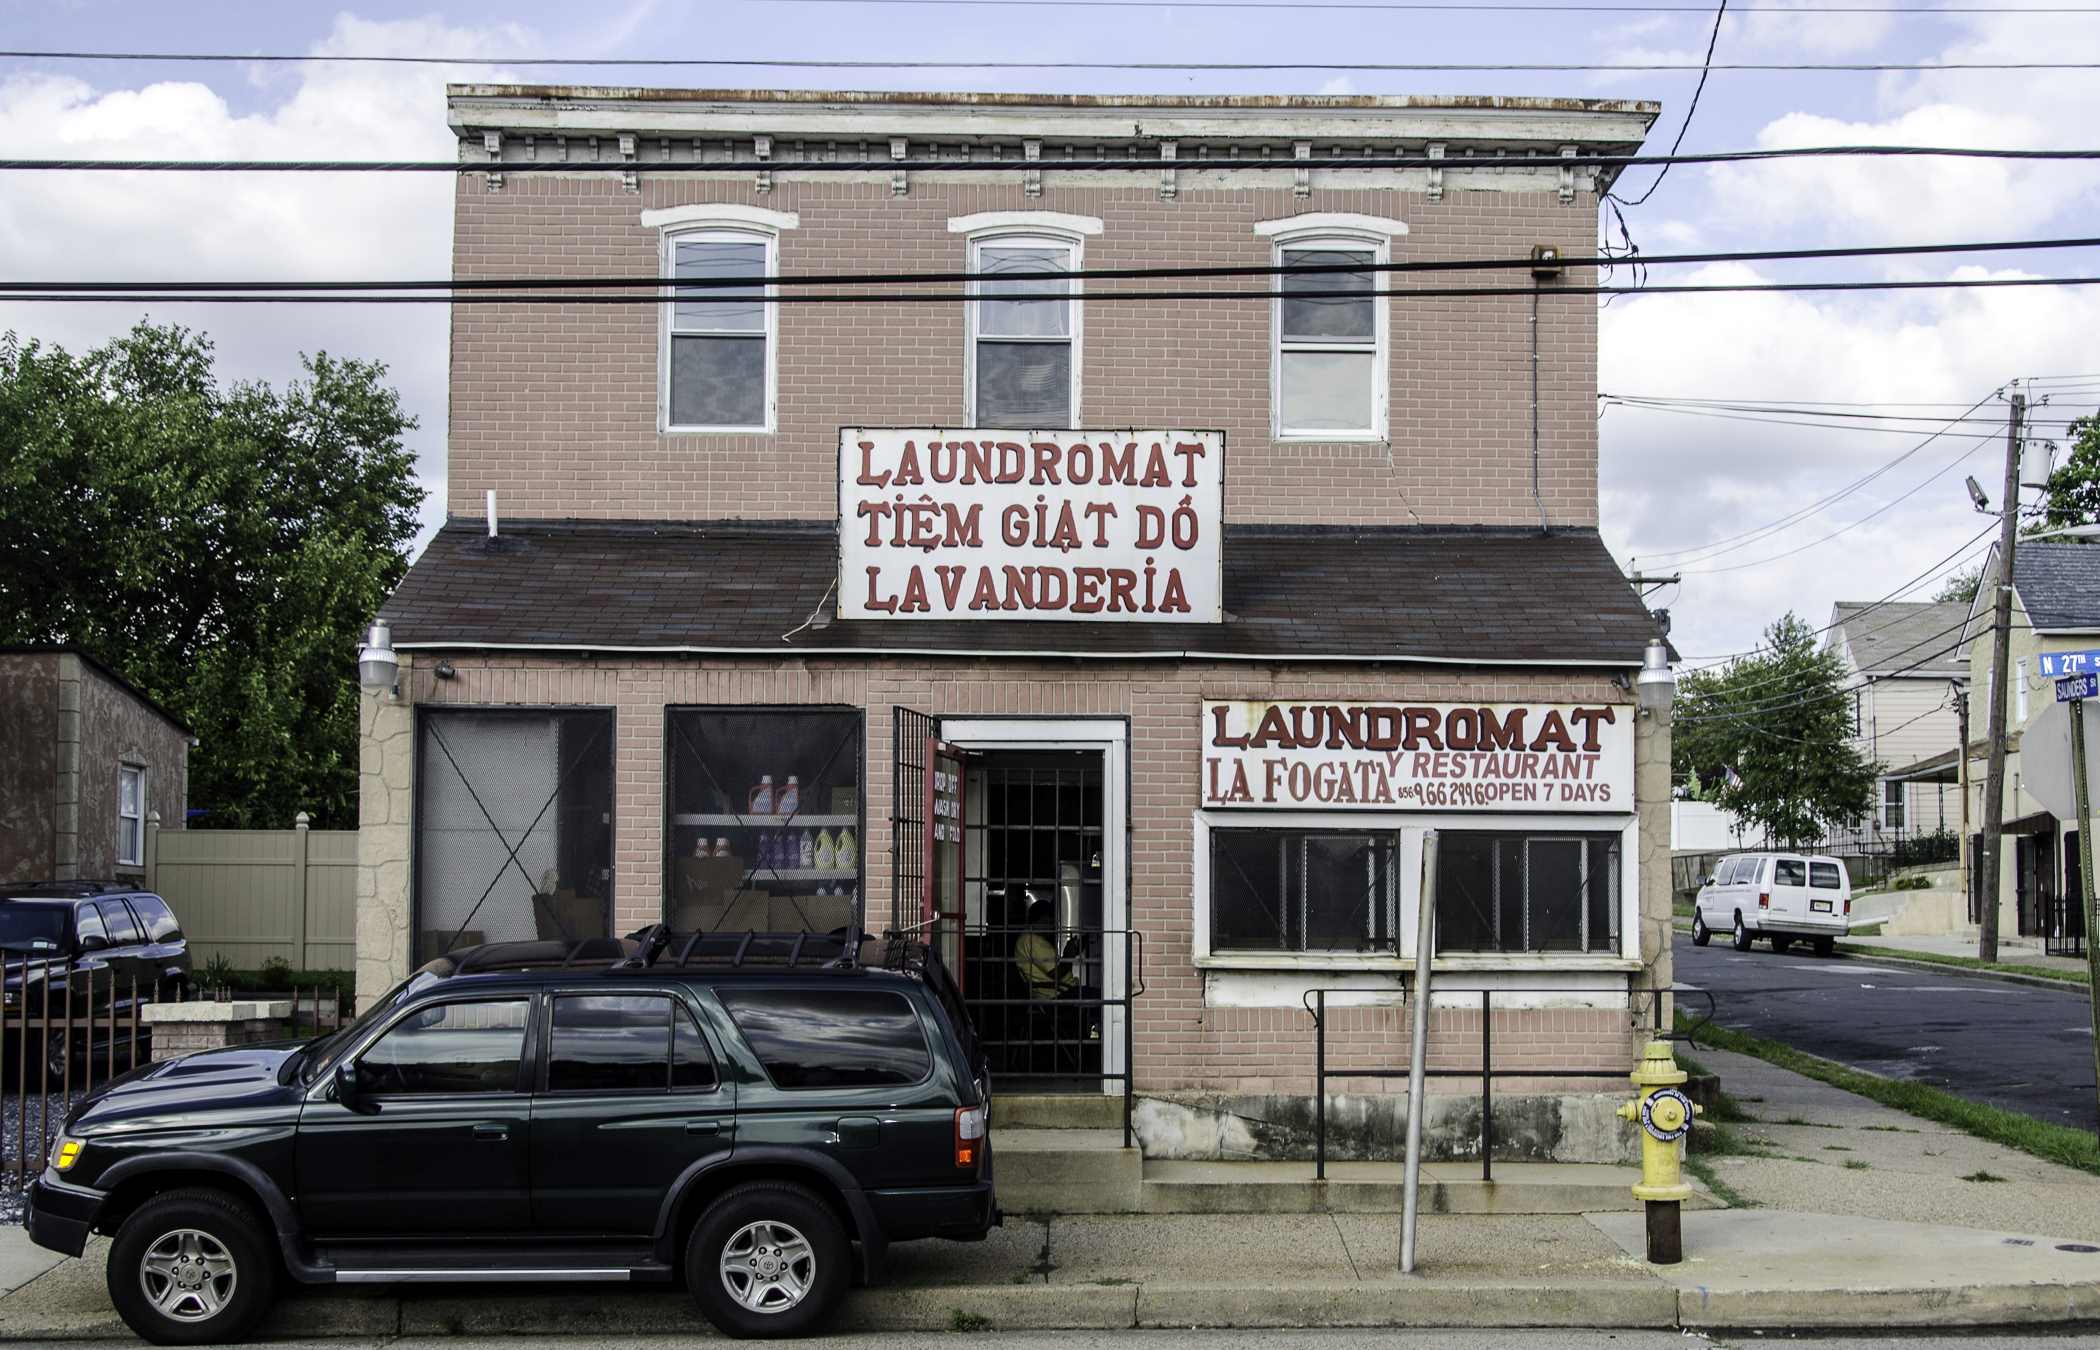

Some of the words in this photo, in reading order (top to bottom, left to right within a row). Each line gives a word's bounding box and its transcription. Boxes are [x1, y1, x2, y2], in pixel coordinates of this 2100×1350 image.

[856, 440, 1206, 489] LAUNDROMAT
[2043, 656, 2053, 674] N
[2056, 677, 2088, 699] SAUNDERS
[1211, 705, 1615, 751] LAUNDROMAT
[1385, 751, 1405, 778] Y
[1412, 752, 1601, 780] RESTAURANT
[1206, 757, 1254, 805] LA
[1262, 756, 1396, 804] FOGATA
[1484, 782, 1531, 801] OPEN
[1544, 783, 1554, 801] 7
[1561, 783, 1611, 802] DAYS
